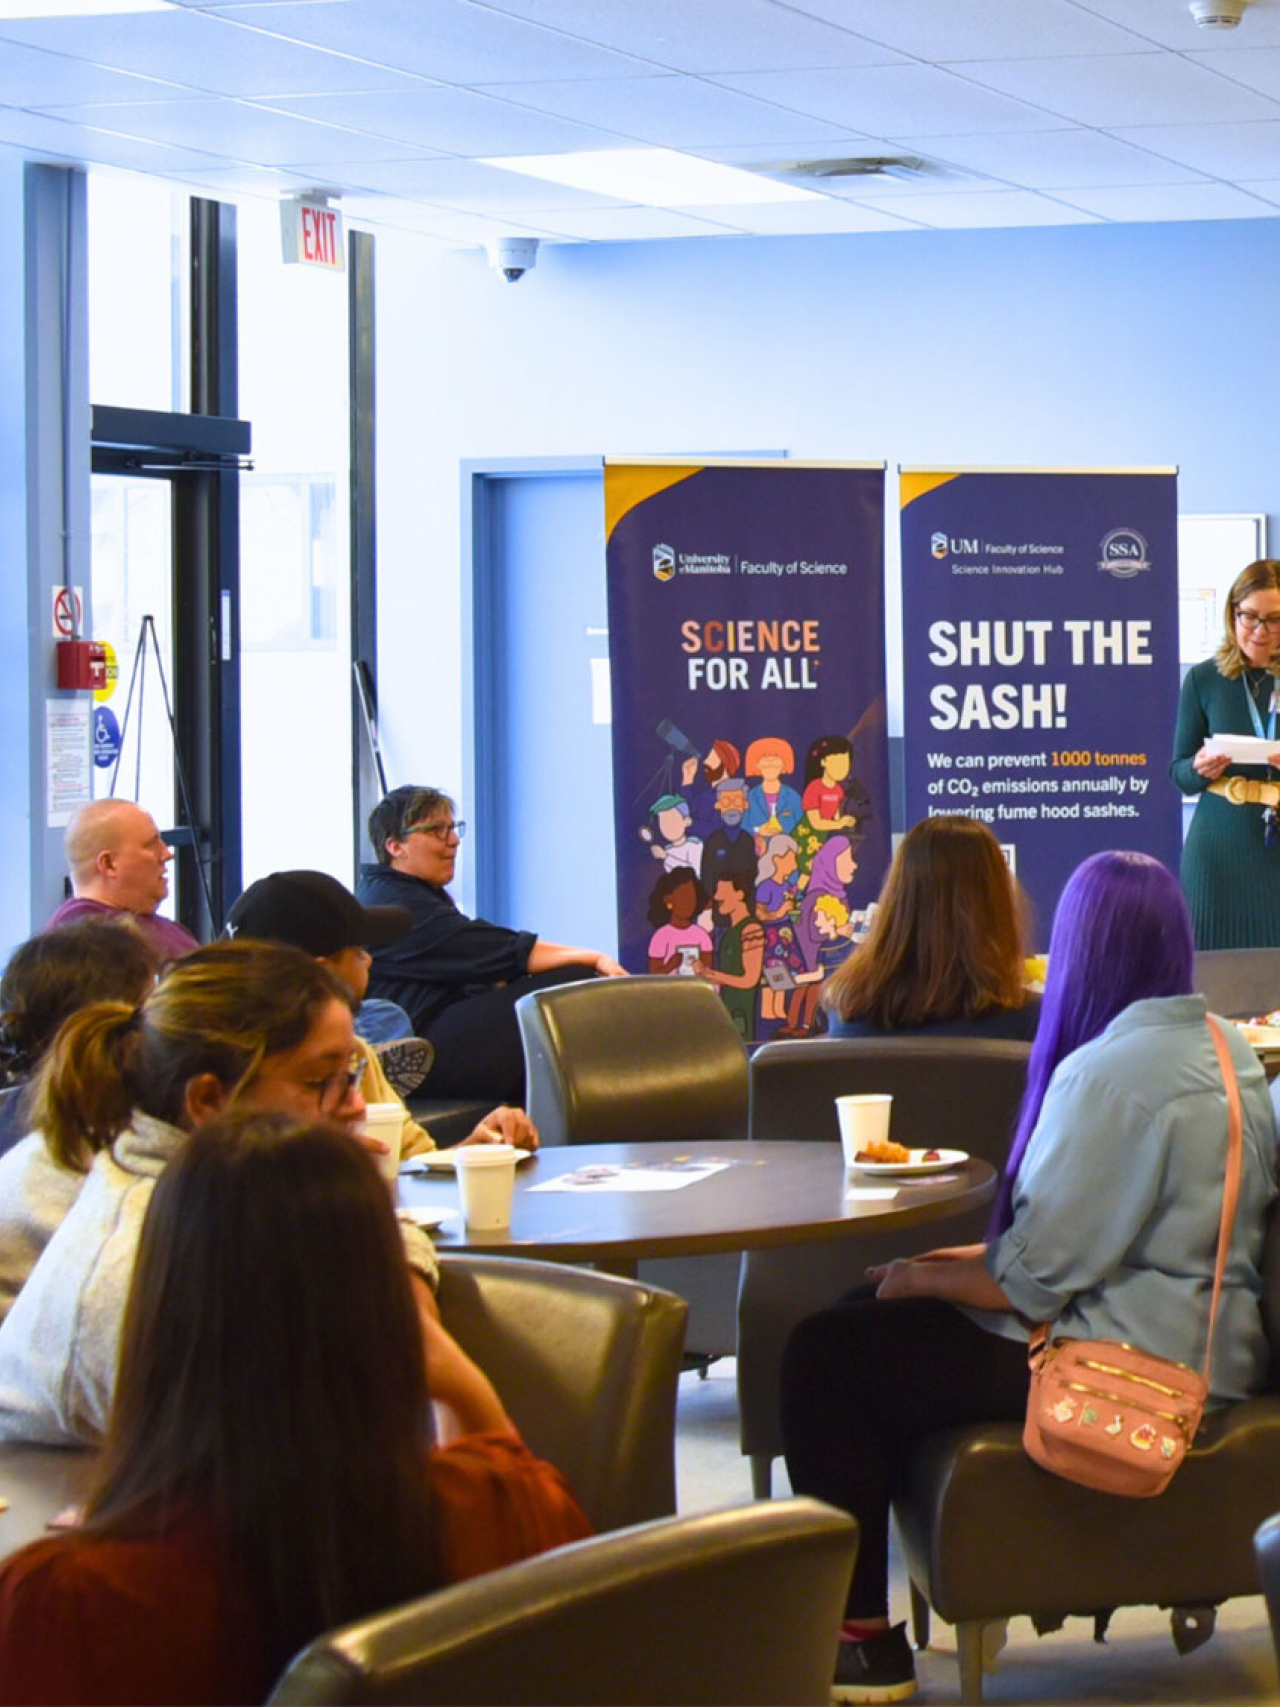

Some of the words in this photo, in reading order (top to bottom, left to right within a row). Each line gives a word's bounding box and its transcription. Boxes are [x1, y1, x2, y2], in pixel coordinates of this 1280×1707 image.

[301, 206, 336, 265] EXIT
[950, 538, 979, 555] UM
[985, 544, 1017, 556] Faculty
[1018, 544, 1028, 555] of
[1029, 544, 1065, 555] Science
[1109, 543, 1140, 557] SSA
[678, 554, 731, 565] University
[740, 561, 783, 577] Faculty
[785, 561, 797, 575] of
[799, 561, 848, 575] Science
[951, 564, 989, 575] Science
[992, 563, 1040, 575] Innovation
[1043, 563, 1065, 575] Hub
[681, 620, 821, 653] SCIENCE
[928, 620, 1053, 667] SHUT
[1064, 620, 1153, 666] THE
[688, 657, 750, 691] FOR
[929, 683, 1068, 730] SASH!
[927, 752, 952, 769] We
[955, 754, 984, 769] can
[987, 752, 1047, 771] prevent
[1051, 750, 1091, 767] 1000
[1094, 751, 1148, 767] tonnes
[927, 778, 945, 795] of
[981, 777, 1059, 794] emissions
[1061, 775, 1128, 795] annually
[1129, 775, 1149, 795] by
[997, 803, 1037, 820] fume
[1041, 802, 1080, 819] hood
[1083, 801, 1140, 818] sashes.
